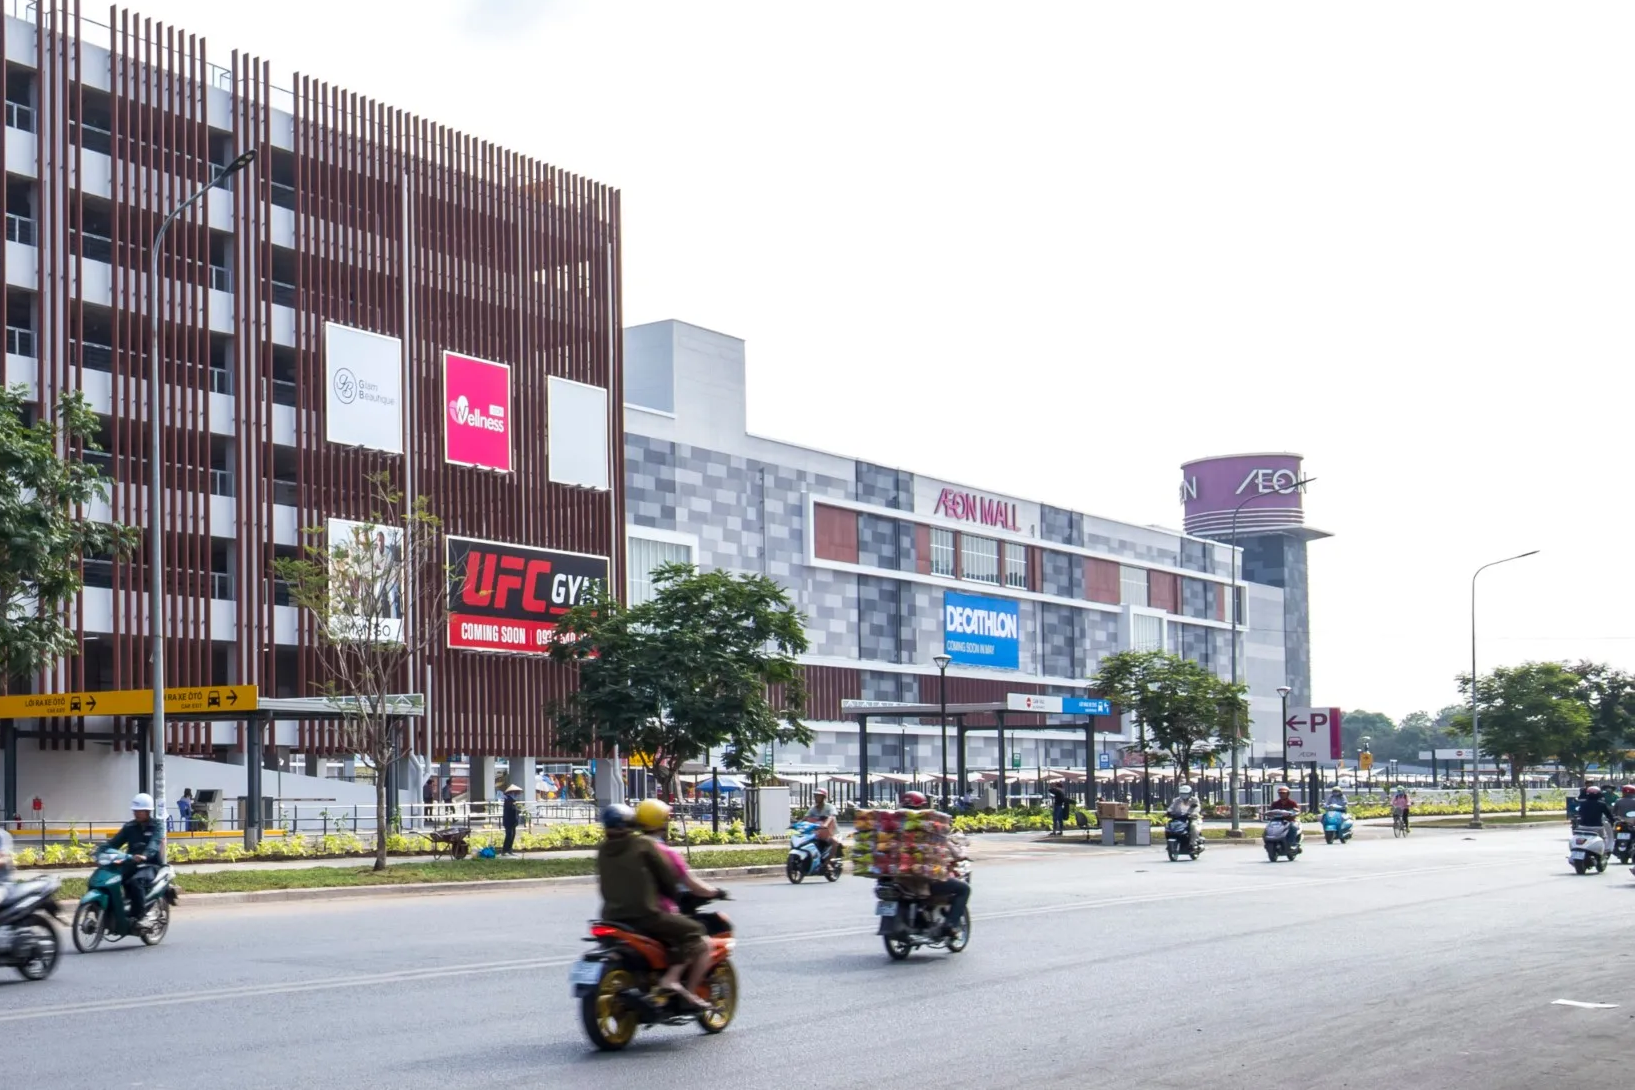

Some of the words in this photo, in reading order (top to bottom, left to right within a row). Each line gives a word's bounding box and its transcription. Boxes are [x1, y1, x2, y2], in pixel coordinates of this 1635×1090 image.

[979, 496, 1021, 532] MALL
[462, 551, 552, 613] UFC
[946, 605, 1018, 639] DECATHLON
[461, 622, 499, 642] COMING
[500, 625, 526, 645] SOON
[947, 640, 966, 652] COMING
[966, 641, 980, 654] SOON
[36, 698, 44, 707] RA
[45, 698, 52, 706] XE
[178, 692, 186, 700] XE
[1310, 713, 1328, 733] P
